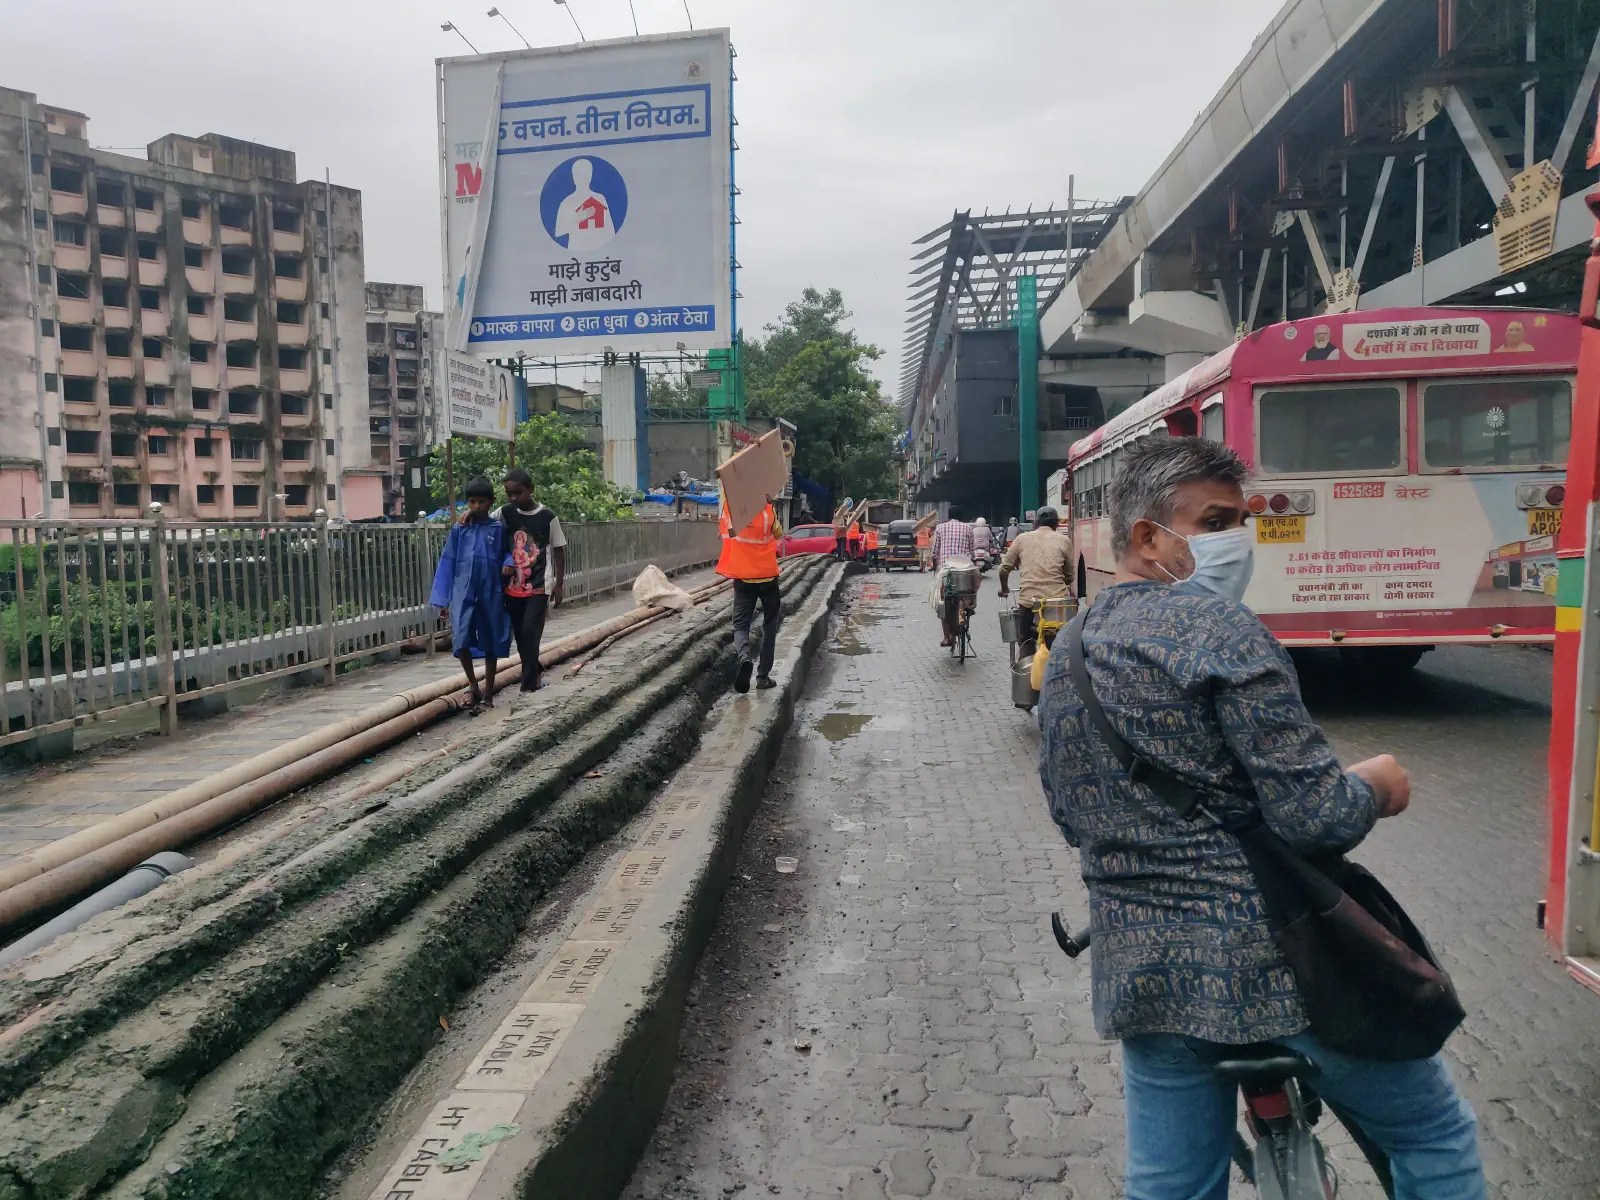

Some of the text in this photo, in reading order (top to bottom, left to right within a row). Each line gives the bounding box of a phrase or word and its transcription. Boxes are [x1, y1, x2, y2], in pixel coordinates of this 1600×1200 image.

[512, 117, 572, 140] वचन.
[576, 106, 620, 134] तीन
[624, 101, 700, 130] नियम.
[548, 256, 622, 283] माझे कुटुंब
[530, 279, 642, 307] माझी जबाबदारी
[486, 321, 518, 336] मास्क
[521, 318, 556, 334] वापरा
[577, 316, 601, 332] हात
[604, 314, 629, 334] धुवा
[650, 309, 679, 327] अंतर
[683, 307, 709, 325] ठेवा
[1367, 323, 1480, 339] दशकों में जो न हो पाया
[1396, 340, 1407, 353] में
[1432, 339, 1479, 352] दिखाया
[1394, 484, 1432, 500] बेस्ट
[1536, 511, 1563, 522] MH.
[1288, 552, 1309, 562] 2.61
[1387, 550, 1400, 559] का
[1285, 566, 1295, 575] 10
[546, 958, 578, 981] TATA
[565, 948, 612, 994] HT CABLE
[476, 1013, 540, 1076] HT CABLE
[522, 1028, 561, 1059] TATA
[436, 1106, 470, 1130] HT
